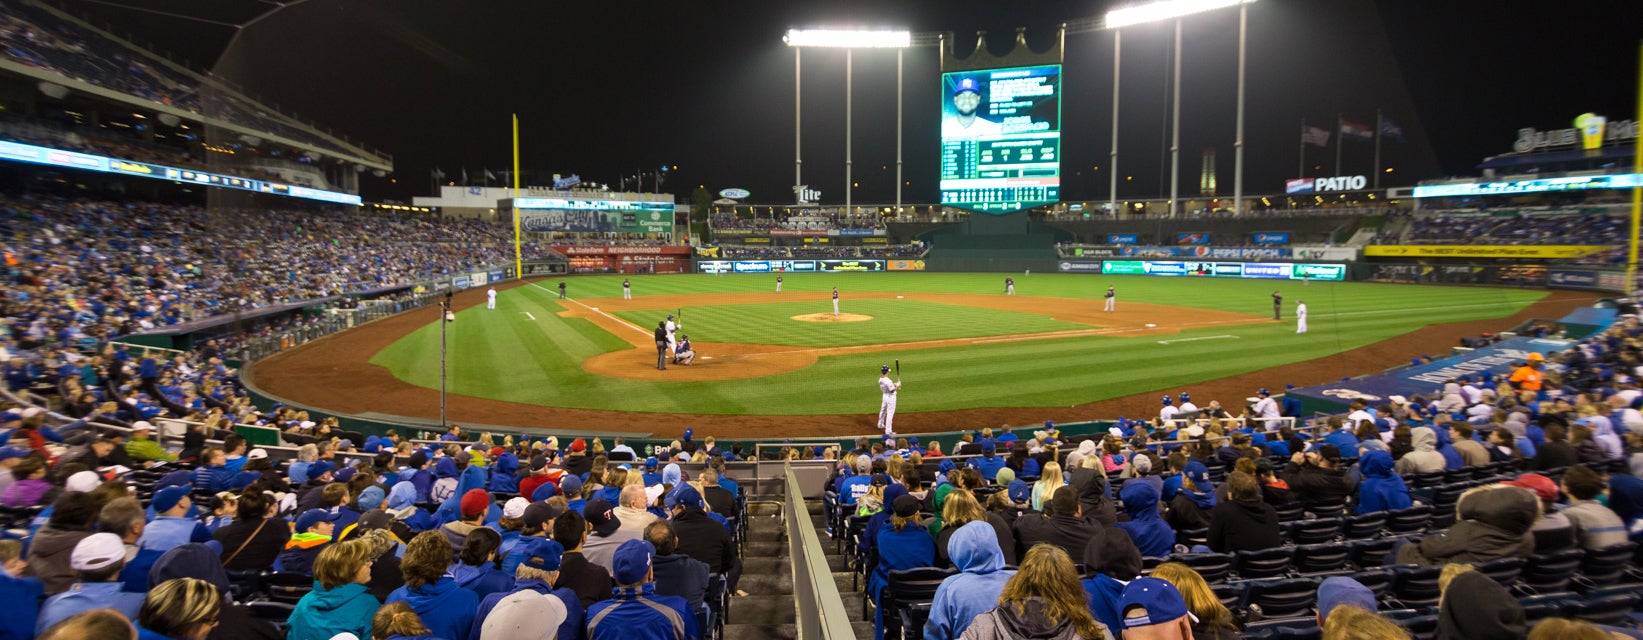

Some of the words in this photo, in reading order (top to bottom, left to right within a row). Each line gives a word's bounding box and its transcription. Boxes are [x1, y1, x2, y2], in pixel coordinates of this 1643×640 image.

[1314, 175, 1367, 192] PATIO
[799, 188, 822, 203] Lite
[520, 213, 564, 230] Kansas
[563, 208, 591, 223] City
[1213, 248, 1241, 257] PEPSI
[1242, 248, 1279, 258] PORCH
[735, 262, 769, 271] Spectrum
